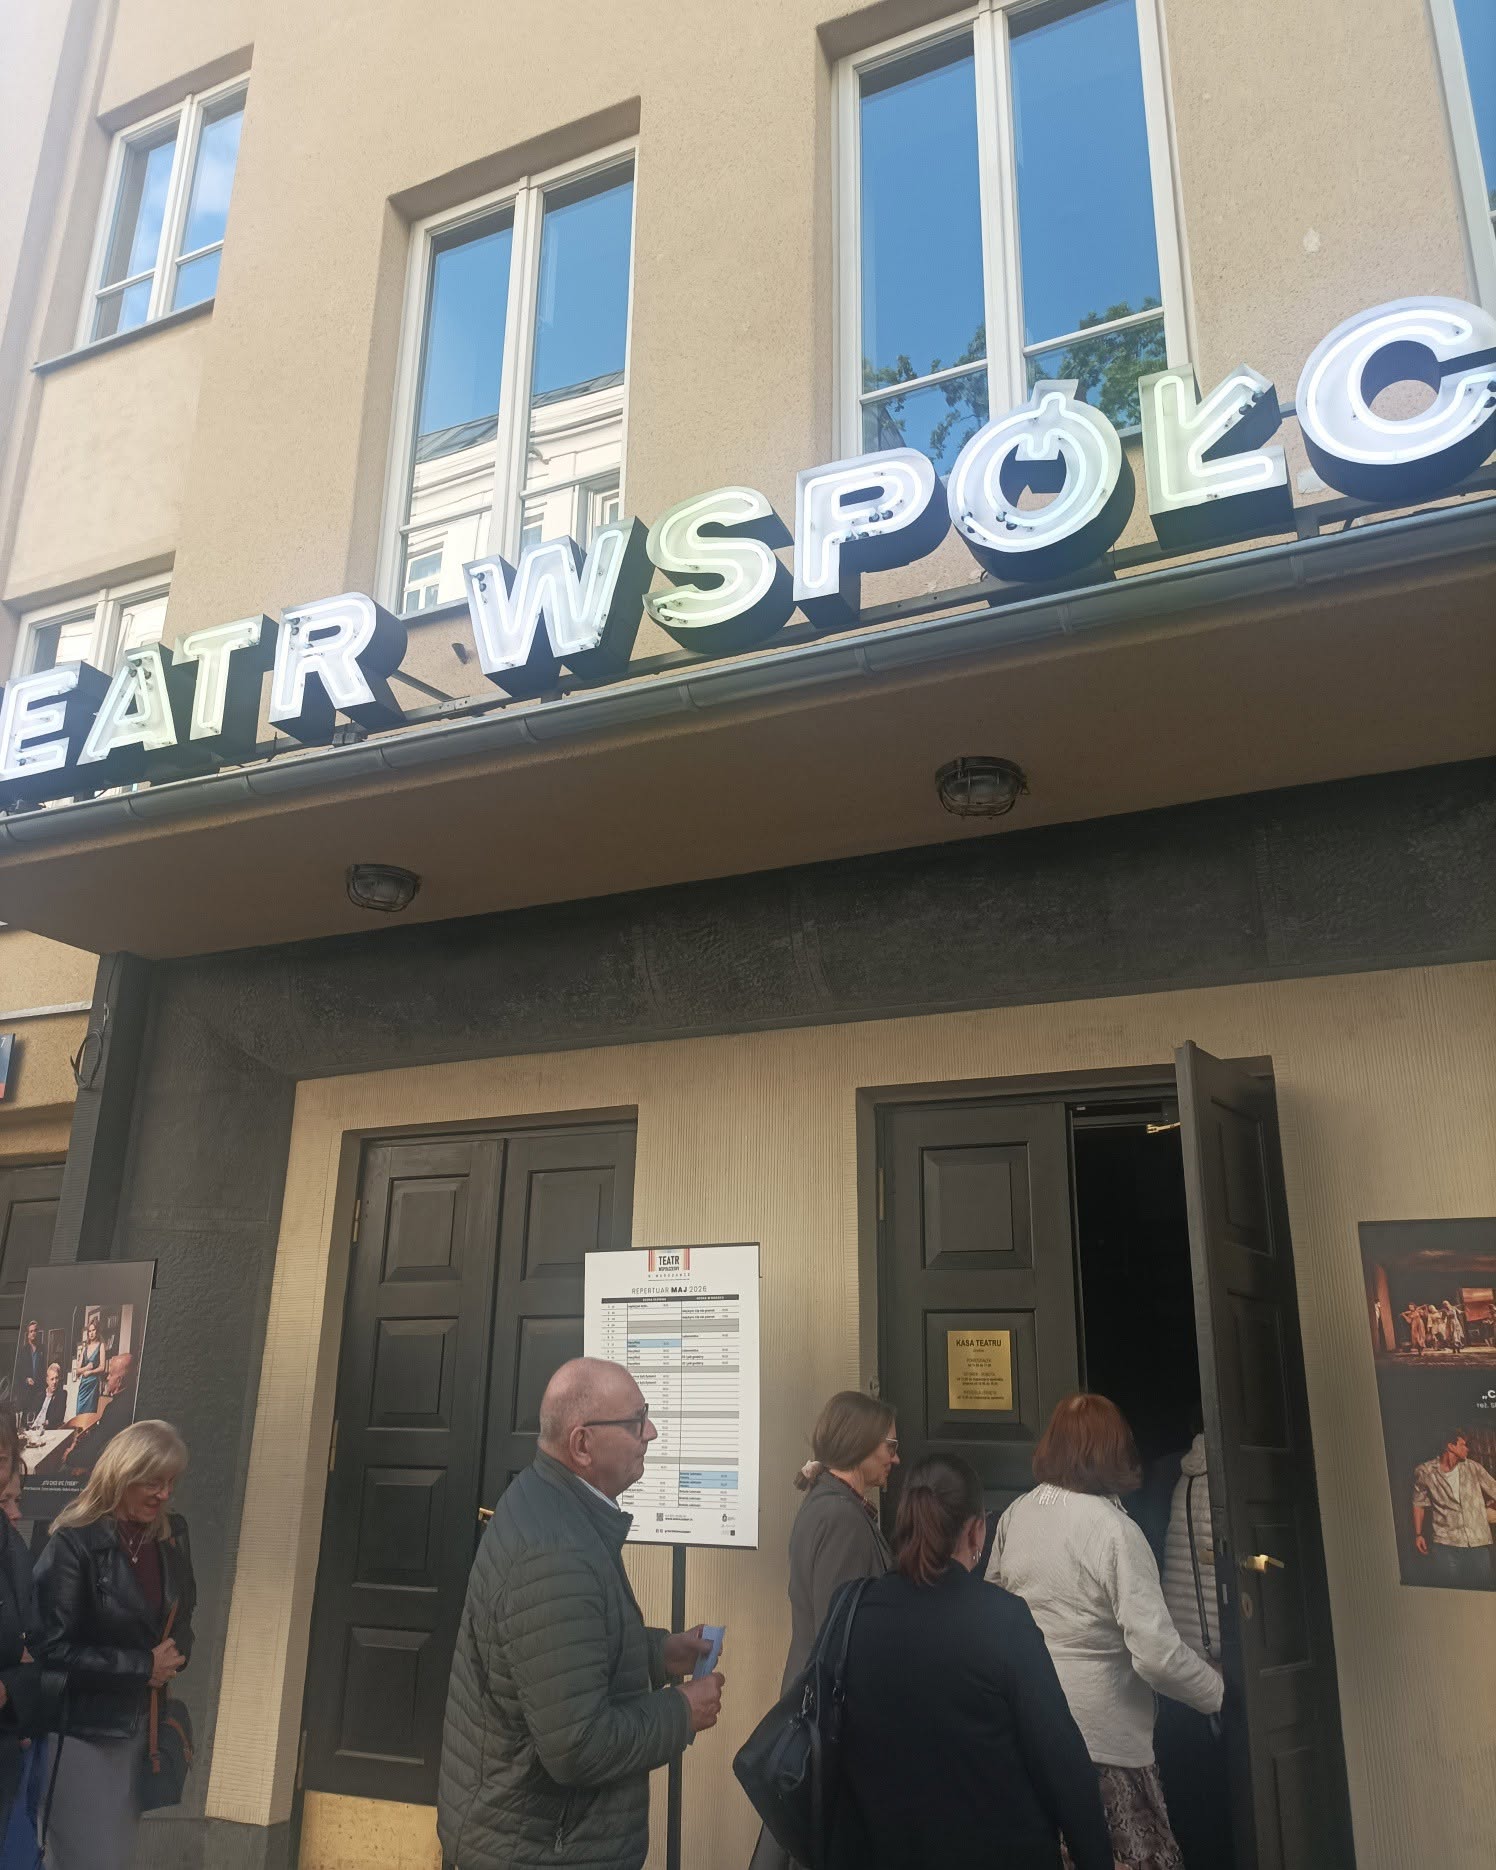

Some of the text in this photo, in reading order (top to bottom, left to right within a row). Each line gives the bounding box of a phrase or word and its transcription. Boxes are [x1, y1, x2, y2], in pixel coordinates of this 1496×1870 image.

[658, 1255, 680, 1266] TEATR
[631, 1287, 670, 1295] REPERTUAR
[689, 1285, 707, 1293] 2026
[956, 1339, 1001, 1347] KASA TEATRU
